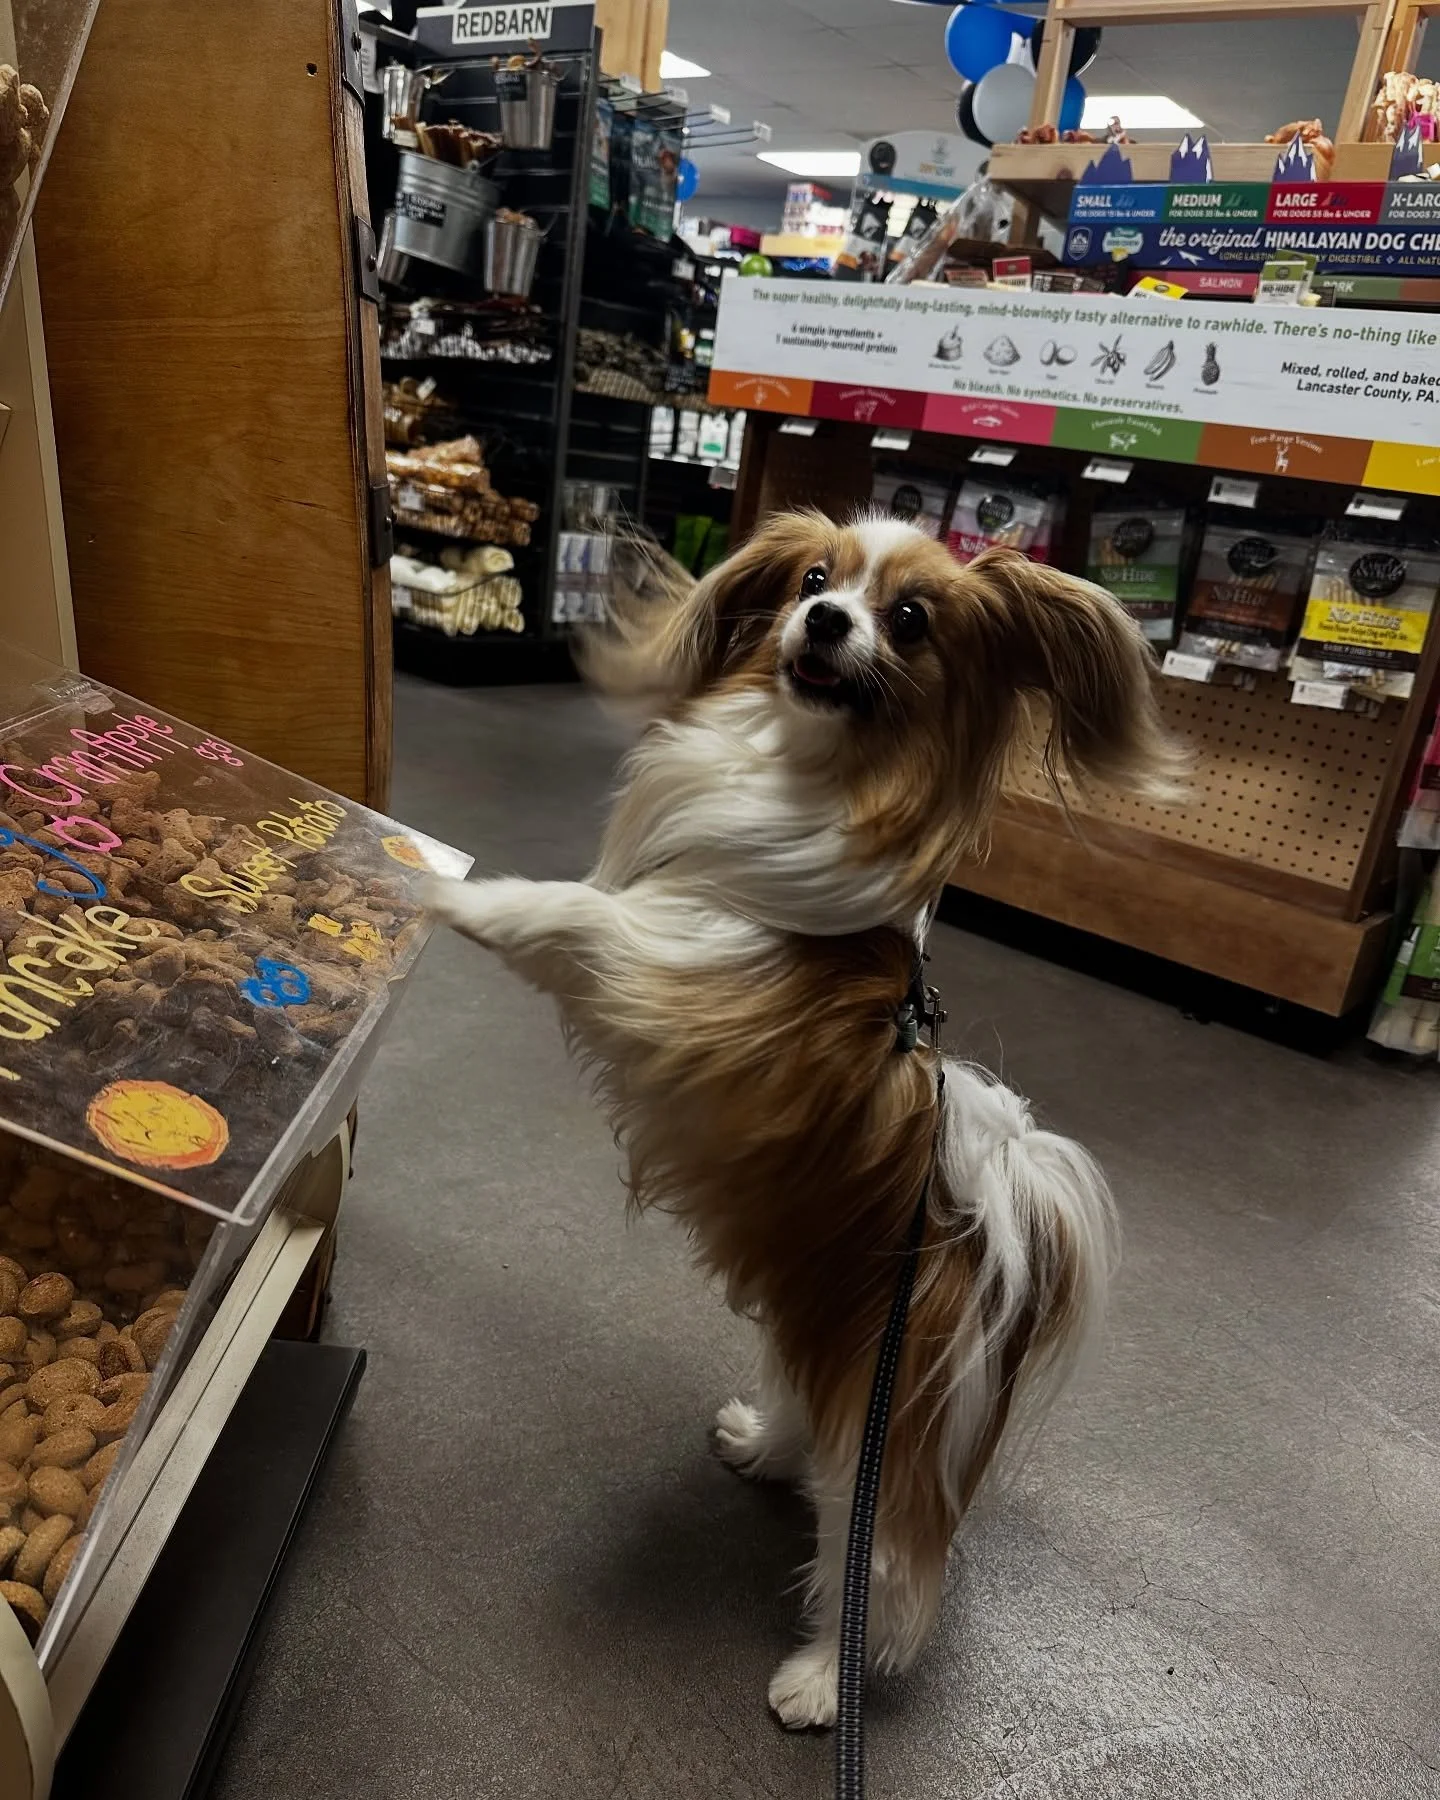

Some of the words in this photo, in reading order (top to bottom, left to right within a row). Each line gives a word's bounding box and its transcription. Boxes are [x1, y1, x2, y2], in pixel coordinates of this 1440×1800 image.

[457, 7, 548, 38] REDBARN
[1077, 194, 1112, 207] SMALL
[1172, 194, 1222, 207] MEDIUM
[1275, 193, 1319, 207] LARGE
[1169, 209, 1183, 219] FOR
[1184, 209, 1204, 219] DOGS
[1225, 209, 1231, 219] &
[1232, 209, 1258, 219] UNDER
[1273, 209, 1288, 219] FOR
[1289, 209, 1311, 219] DOGS
[1335, 209, 1341, 219] &
[1343, 209, 1371, 219] UNDER
[1388, 211, 1405, 219] FOR
[1407, 211, 1431, 219] DOGS
[1159, 226, 1186, 247] the
[1188, 227, 1262, 255] original
[1265, 231, 1362, 249] HIMALAYAN
[1365, 232, 1406, 250] DOG
[1244, 252, 1276, 261] LASTIN
[1328, 255, 1383, 265] DIGESTIBLE
[1397, 256, 1415, 265] ALL
[1200, 277, 1244, 289] SALMON
[753, 288, 770, 301] The
[772, 291, 800, 304] super
[801, 290, 841, 307] healthy,
[842, 293, 902, 312] delightfully
[904, 299, 974, 318] long-lasting,
[977, 303, 1070, 323] mind-blowingly
[1075, 309, 1107, 325] tasty
[1110, 312, 1183, 329] alternative
[1187, 316, 1201, 330] to
[1204, 317, 1268, 335] rawhide.
[1273, 320, 1328, 338] There's
[1333, 326, 1401, 346] no-thing
[1406, 329, 1437, 346] like
[799, 324, 826, 337] simple
[829, 327, 875, 340] ingredients
[782, 336, 864, 352] sustainably-sourced
[866, 343, 898, 354] protein
[1281, 362, 1322, 378] Mixed,
[1325, 365, 1369, 381] rolled,
[1372, 370, 1399, 384] and
[952, 379, 966, 391] No
[968, 380, 1003, 395] bleach.
[1006, 385, 1021, 397] No
[1023, 387, 1080, 404] synthetics.
[1083, 391, 1098, 403] No
[1101, 393, 1184, 414] preservatives.
[1296, 379, 1361, 396] Lancaster
[1363, 384, 1412, 403] County,
[1416, 389, 1440, 403] PA.
[1250, 433, 1294, 446] Free-Range
[0, 711, 190, 806] Cran-Apple
[180, 839, 298, 914] Sweet
[256, 797, 348, 851] Potato
[0, 905, 161, 1048] ancake
